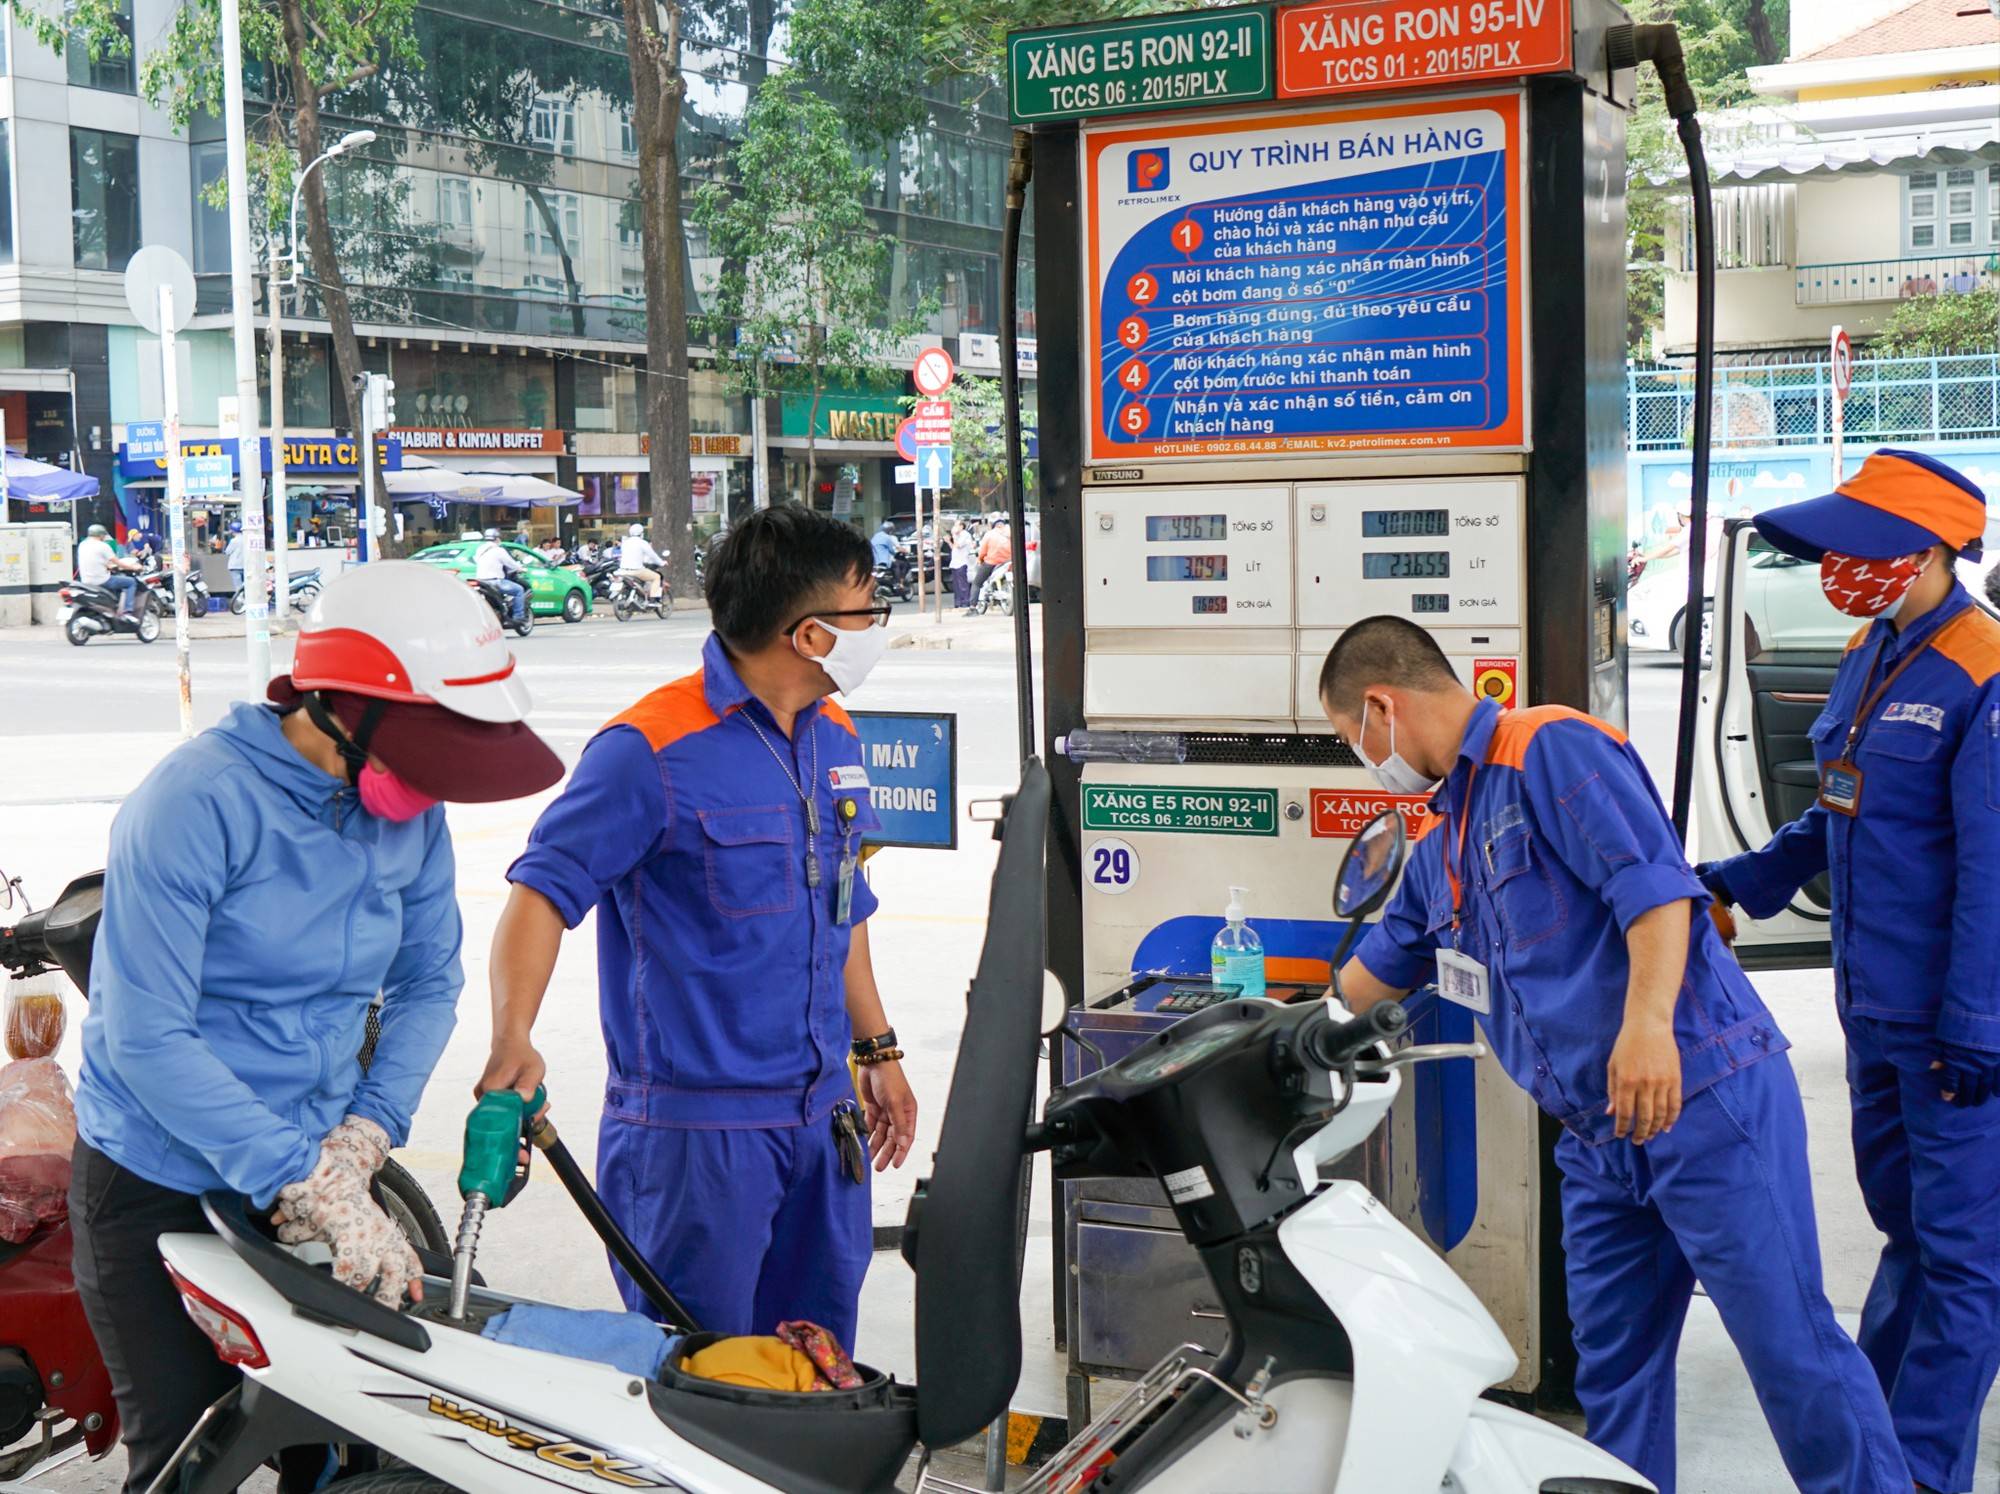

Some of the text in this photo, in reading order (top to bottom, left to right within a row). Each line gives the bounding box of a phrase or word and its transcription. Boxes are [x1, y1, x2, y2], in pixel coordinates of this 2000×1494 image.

[1298, 0, 1546, 52] XĂNG RON 95-IV
[1027, 26, 1251, 80] XĂNG E5 RON 92-II
[1322, 56, 1378, 84] TCCS
[1384, 53, 1406, 78] 01
[1425, 41, 1521, 74] 2015/PLX
[1050, 83, 1099, 110] TCCS
[1105, 81, 1126, 105] 06
[1142, 69, 1228, 100] 2015/PLX
[1189, 127, 1483, 173] QUY TRÌNH BÁN HÀNG
[1118, 194, 1180, 206] PETROLIMEX
[1214, 190, 1474, 223] Hướng dẫn khách hàng vào vị trí,
[1179, 225, 1191, 247] 1
[1214, 209, 1448, 241] chào hỏi và xác nhận nhu cầu
[1214, 237, 1336, 258] của khách hàng
[1172, 252, 1470, 284] Mời khách hàng xác nhận màn hình
[1135, 278, 1149, 300] 2
[1172, 290, 1197, 306] cột
[1202, 289, 1236, 302] bơm
[1242, 286, 1282, 301] đang
[1288, 281, 1298, 297] ở
[1303, 279, 1325, 296] số
[1173, 313, 1210, 328] Bơm
[1217, 311, 1260, 326] hàng
[1323, 303, 1345, 319] đủ
[1352, 303, 1392, 318] theo
[1397, 300, 1430, 318] yêu
[1436, 295, 1470, 312] cầu
[1126, 322, 1140, 344] 3
[1173, 328, 1313, 347] của khách hàng
[1174, 342, 1470, 371] Mời khách hàng xác nhận màn hình
[1126, 365, 1141, 387] 4
[1174, 366, 1411, 392] cột bơm trước khi thanh toán
[1174, 389, 1472, 415] Nhận và xác nhận số tiền, cảm ơn
[1127, 408, 1142, 430] 5
[1174, 418, 1274, 434] khách hàng
[446, 433, 456, 447] &
[459, 433, 501, 448] KINTAN
[503, 433, 543, 449] BUFFET
[1154, 436, 1451, 454] HOTLINE: 0902.68.44.88 EMAIL: kv2.petrolimex.com.vn
[281, 444, 332, 464] GUTA
[336, 444, 388, 465] CAE
[1095, 470, 1140, 480] TATSUNO
[1232, 520, 1274, 531] TỔNG SỐ
[1455, 514, 1500, 527] TỔNG SỐ
[1246, 561, 1262, 572] LÍT
[1470, 557, 1486, 569] LÍT
[1236, 599, 1272, 609] ĐƠN GIÁ
[1459, 597, 1497, 607] ĐƠN GIÁ
[1475, 660, 1515, 668] EMERGENCY
[872, 740, 919, 768] MÁY
[870, 786, 936, 812] TRONG
[1092, 791, 1268, 813] XĂNG E5 RON 92-II
[1322, 798, 1428, 817] XĂNG RO
[1110, 812, 1150, 826] TCCS
[1154, 813, 1171, 826] 06
[1185, 814, 1253, 829] 2015/PLX
[1093, 848, 1131, 884] 29
